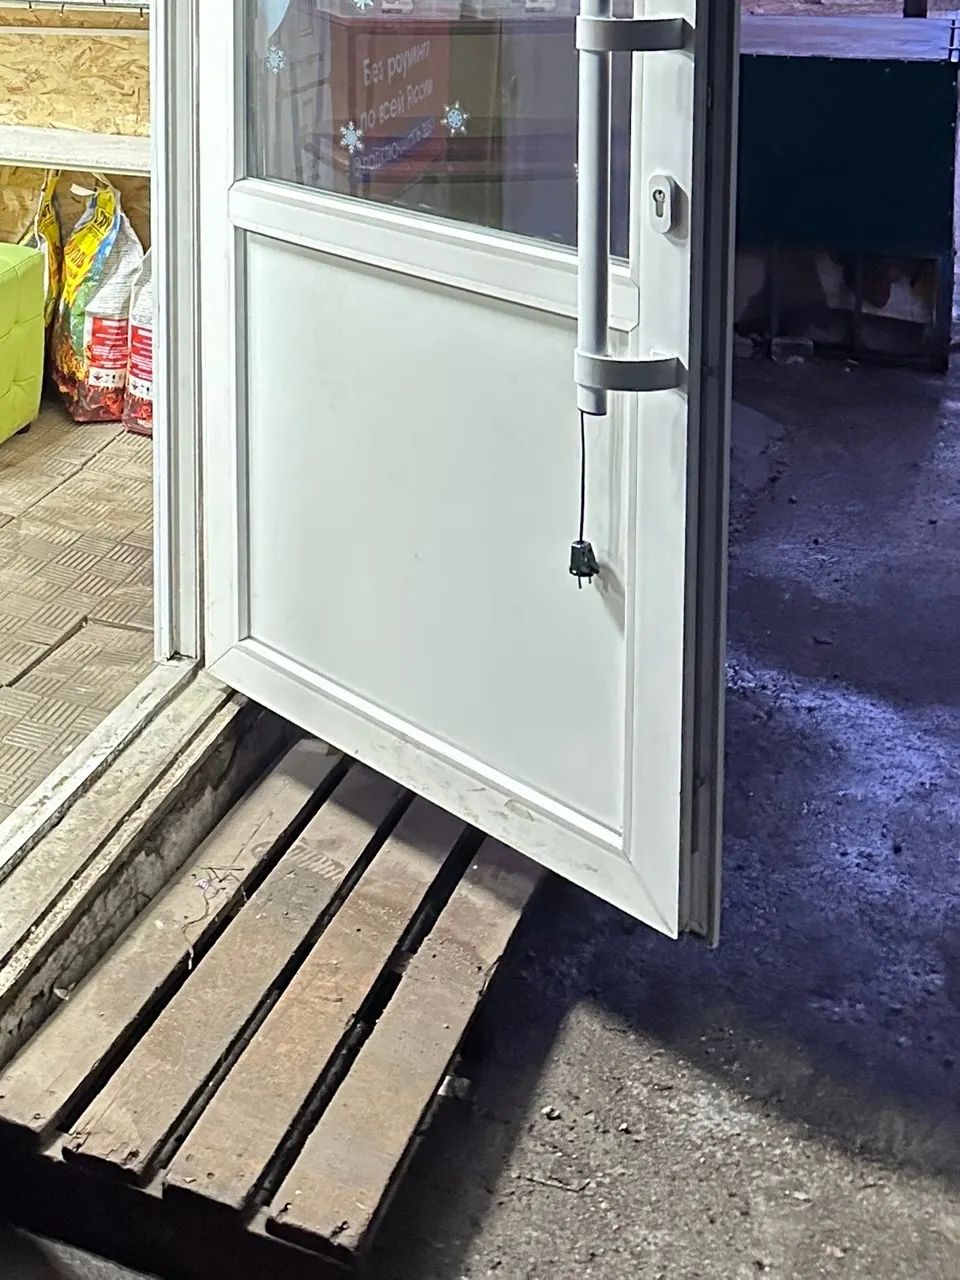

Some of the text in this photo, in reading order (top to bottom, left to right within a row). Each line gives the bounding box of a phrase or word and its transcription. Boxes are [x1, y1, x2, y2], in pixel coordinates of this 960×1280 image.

[361, 58, 384, 87] Без
[359, 110, 376, 131] по
[379, 94, 405, 125] всей
